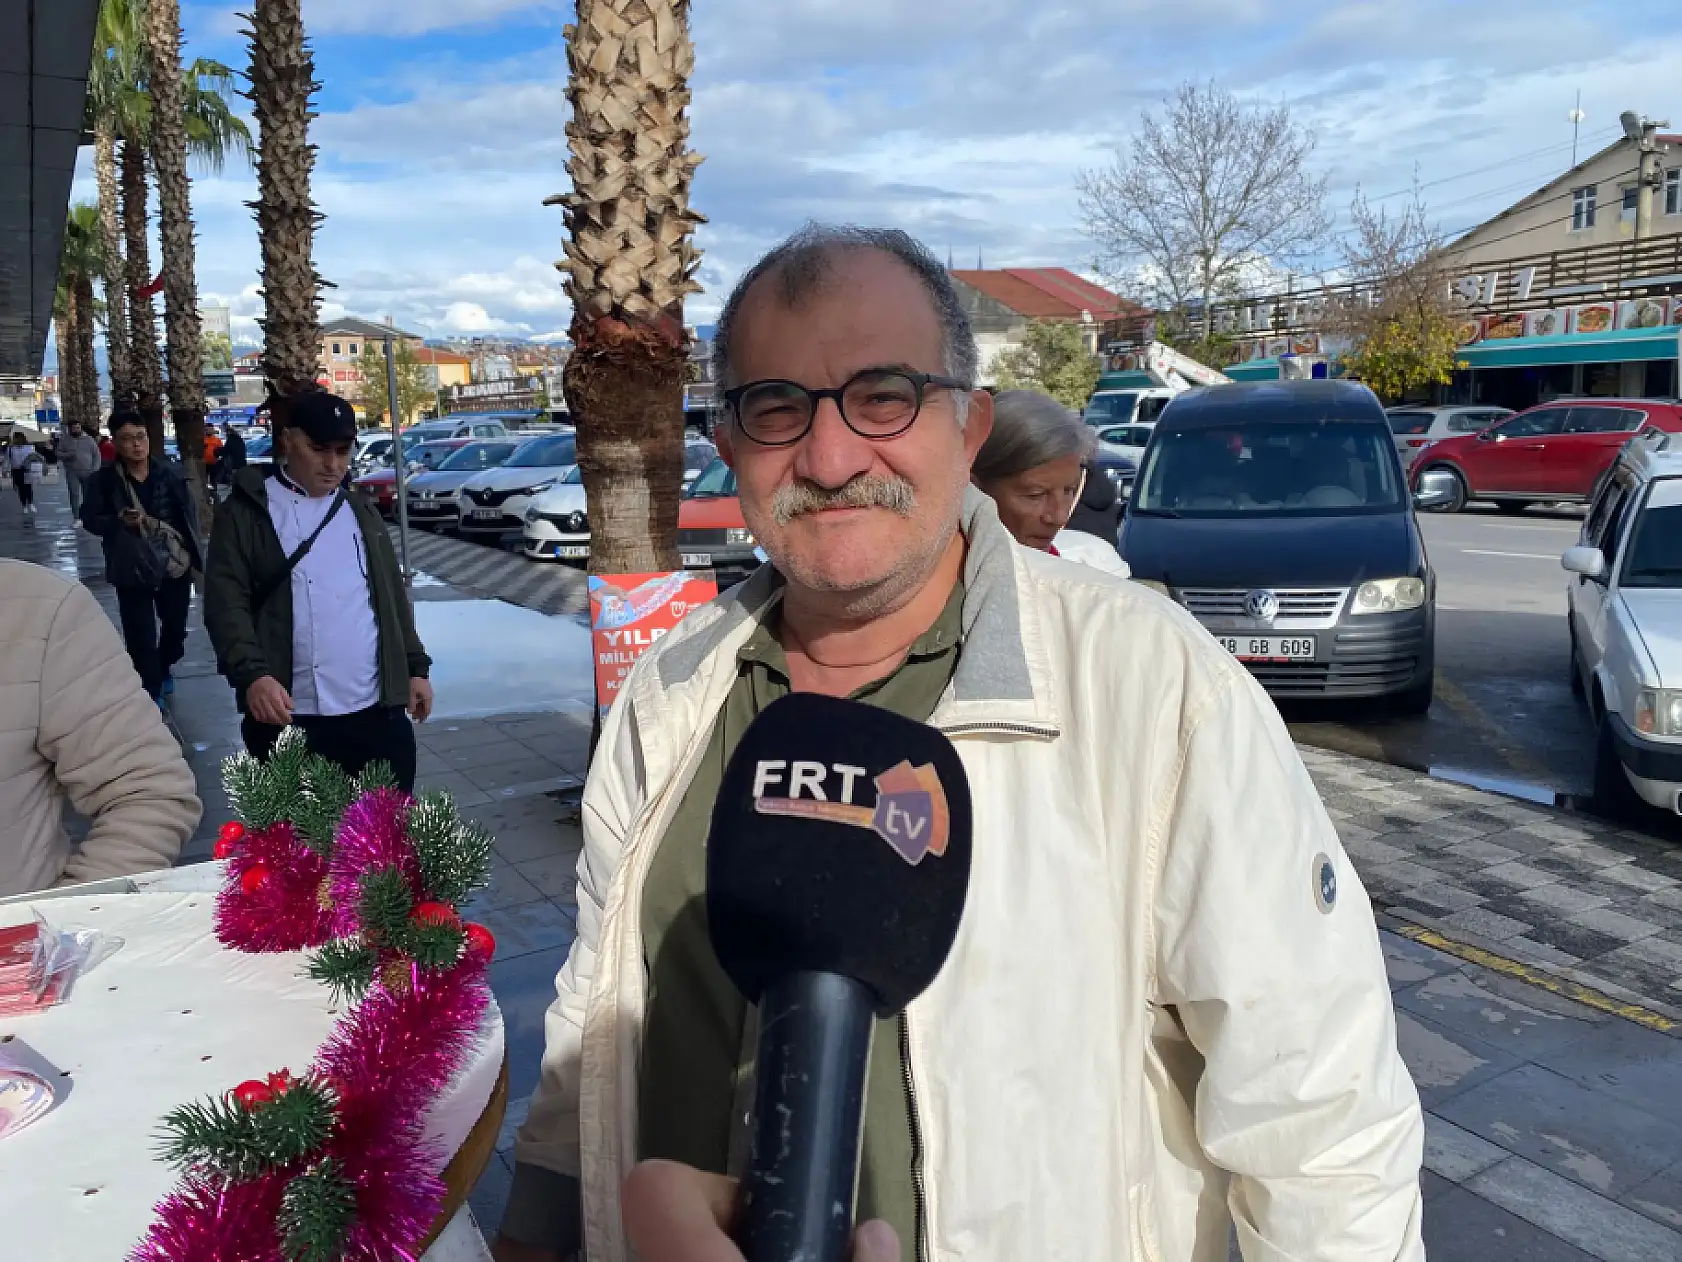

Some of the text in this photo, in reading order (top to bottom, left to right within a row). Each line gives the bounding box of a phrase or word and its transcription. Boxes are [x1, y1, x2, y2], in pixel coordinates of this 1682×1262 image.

[1250, 639, 1269, 654] GB
[1281, 639, 1311, 655] 609
[753, 760, 867, 804] FRT
[886, 800, 926, 839] tv
